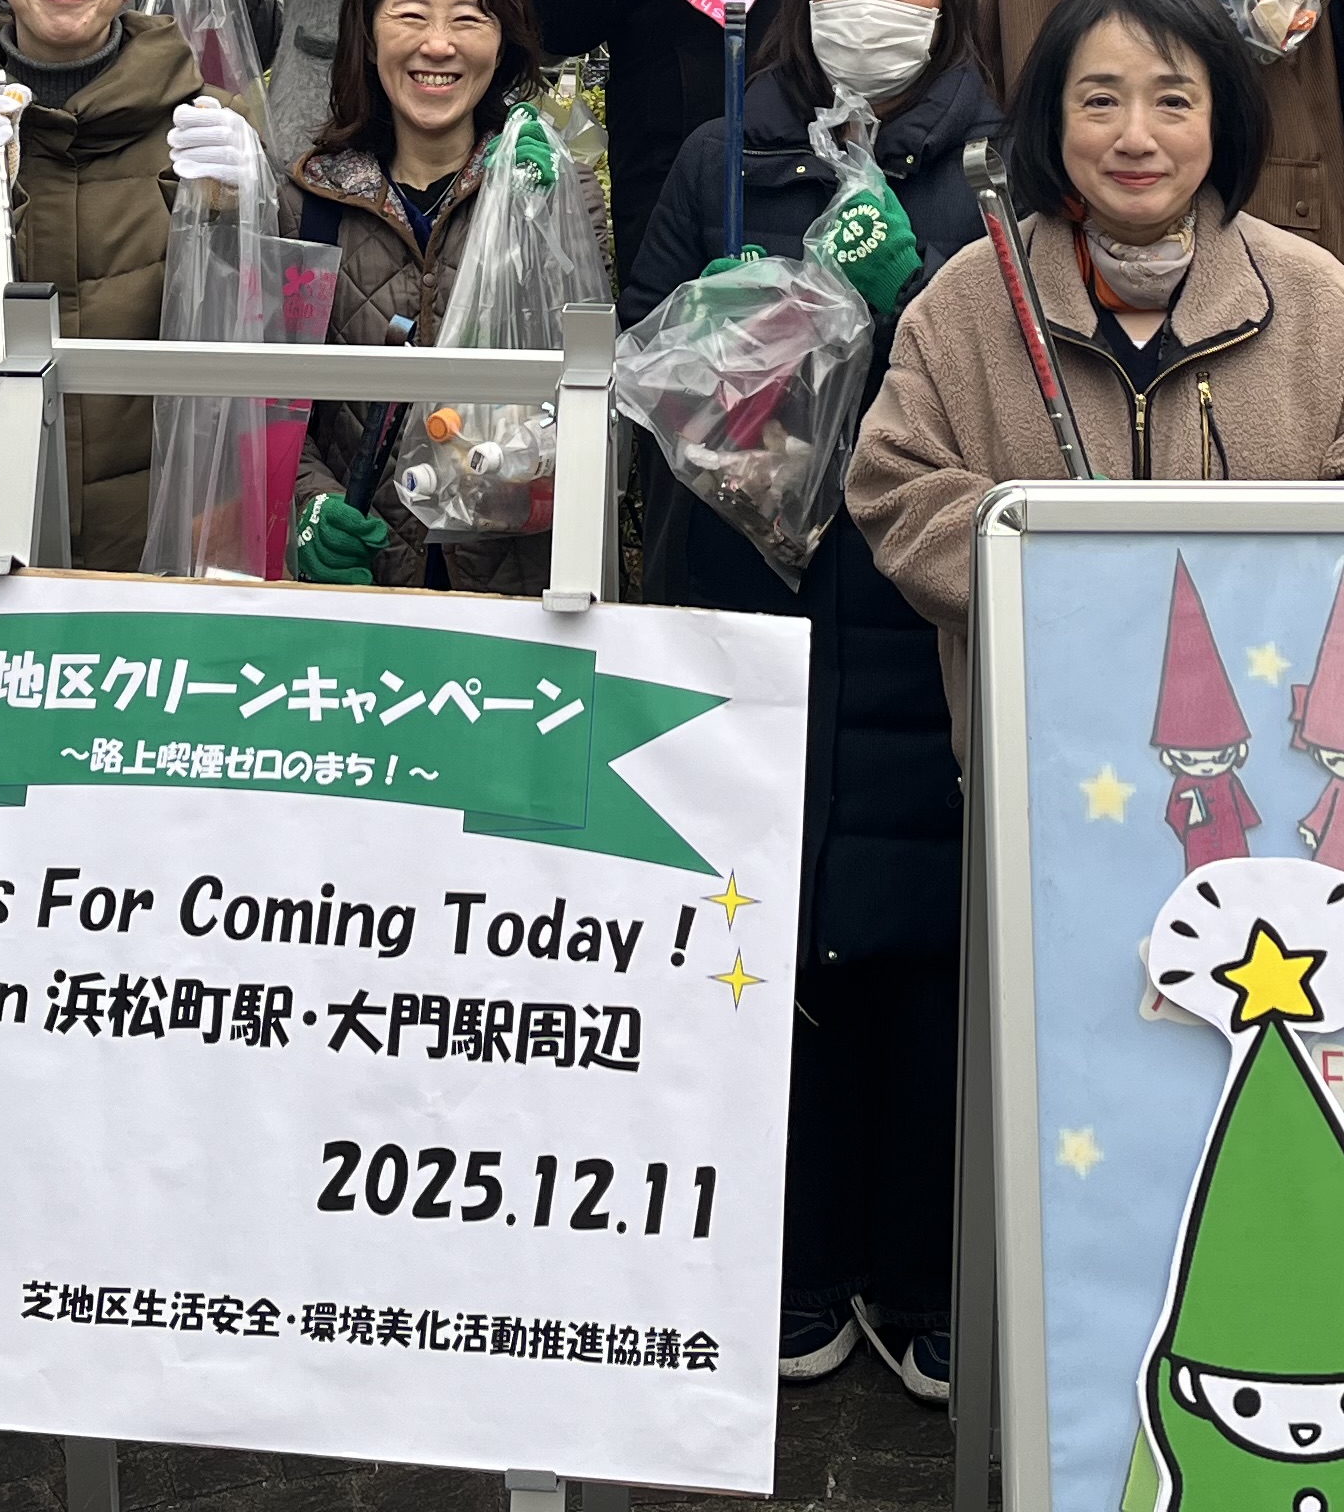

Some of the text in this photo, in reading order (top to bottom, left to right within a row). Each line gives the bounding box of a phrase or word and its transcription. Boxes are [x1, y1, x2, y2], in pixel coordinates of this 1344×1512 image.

[837, 220, 888, 263] ecology
[841, 205, 881, 221] town
[842, 220, 864, 244] 48
[37, 867, 155, 936] For
[178, 874, 417, 957] Coming
[443, 891, 645, 976] Today
[43, 970, 644, 1077] 浜松町駅・大門駅周辺
[316, 1138, 720, 1241] 2025.12.11
[21, 1281, 722, 1374] 芝地区生活安全・環境美化活動推進協議会
